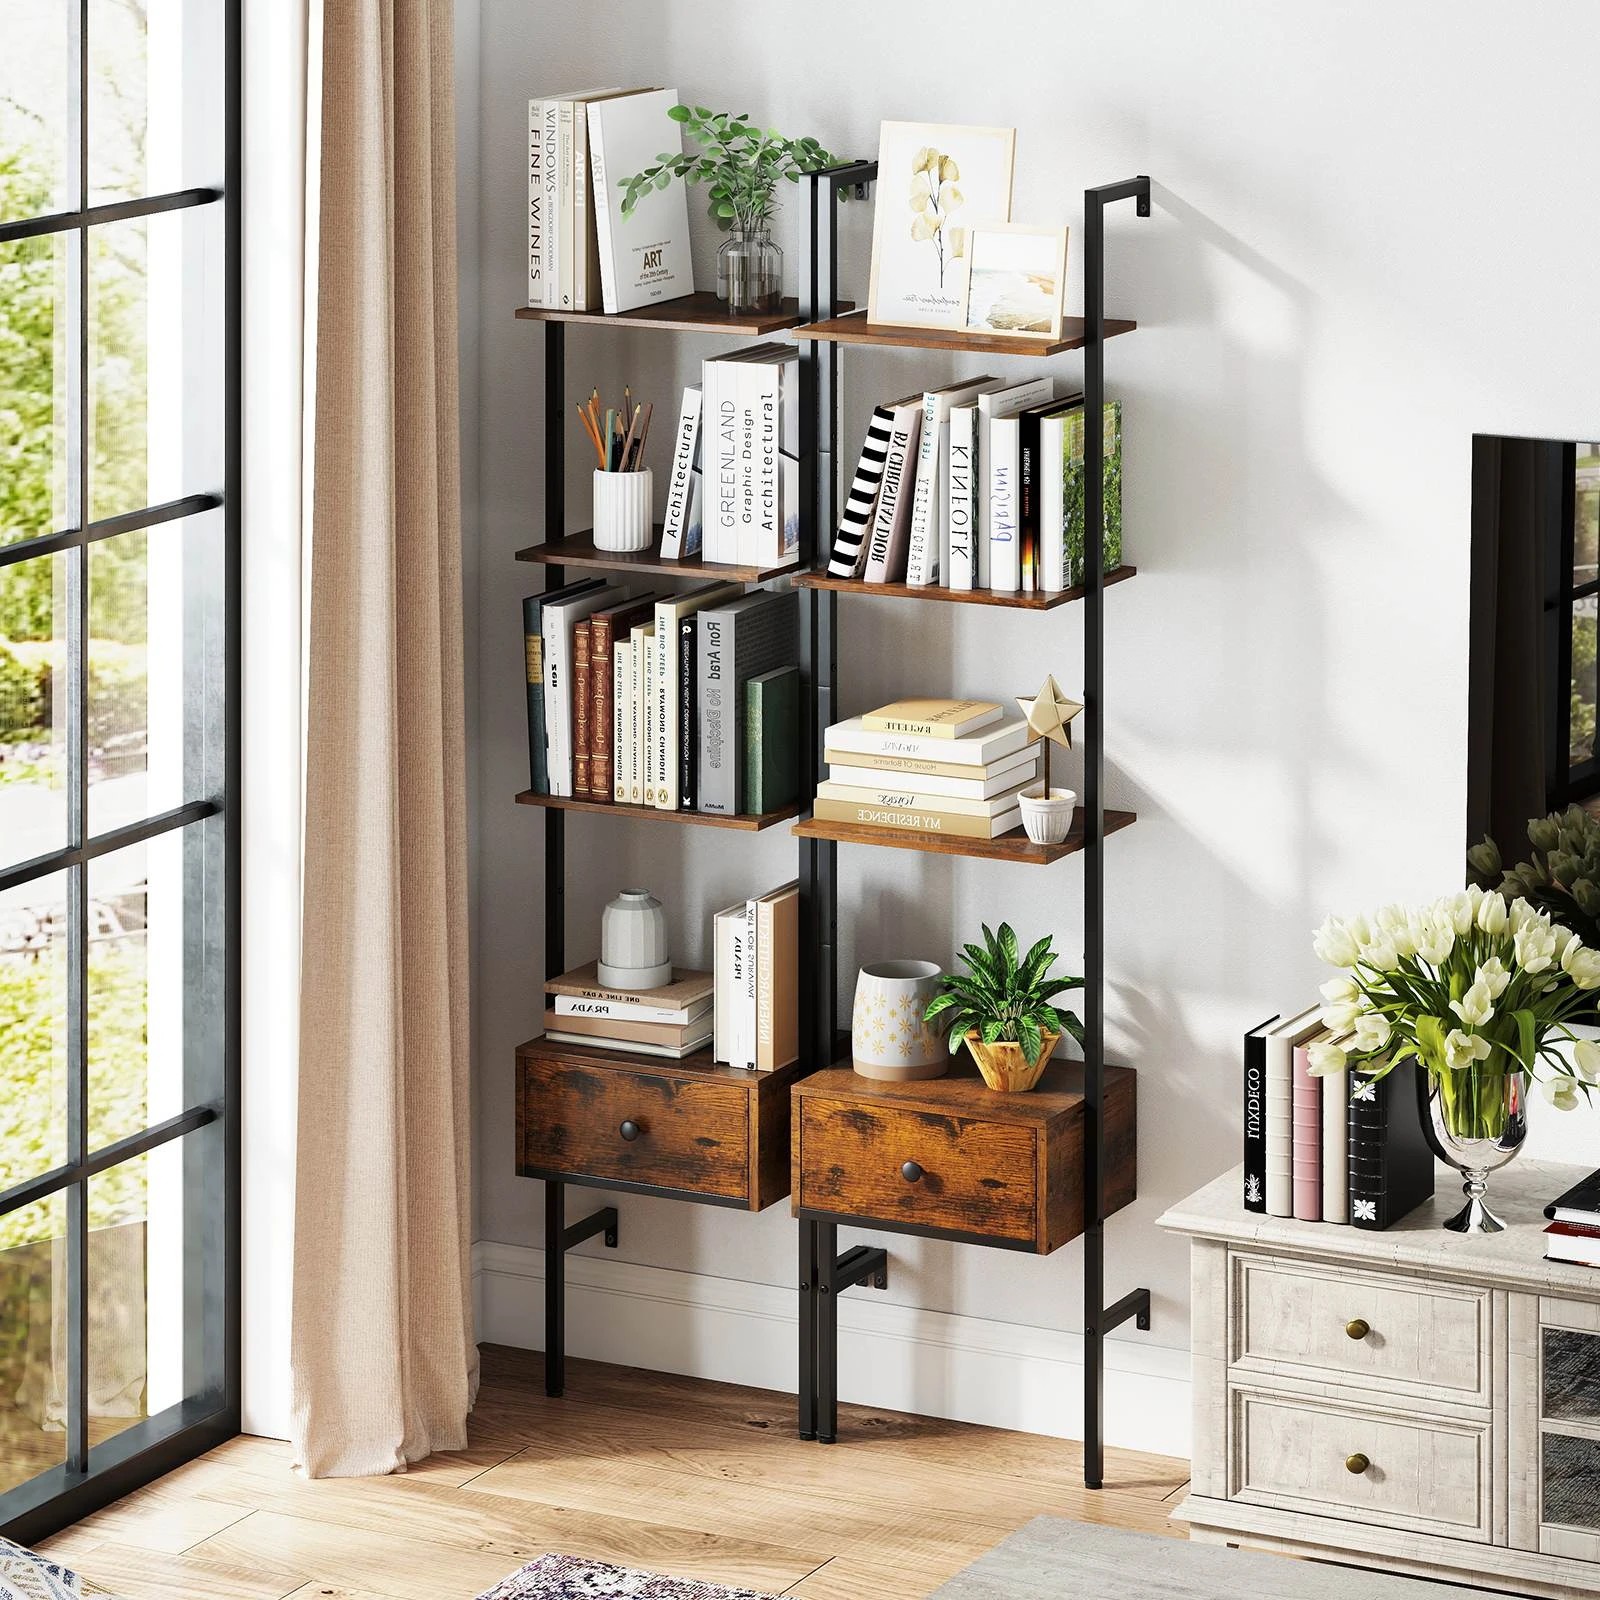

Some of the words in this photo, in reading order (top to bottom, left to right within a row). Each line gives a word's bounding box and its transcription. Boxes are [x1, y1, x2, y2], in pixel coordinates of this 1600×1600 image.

[531, 129, 541, 185] FINE
[546, 108, 556, 193] WINDOWS
[591, 153, 604, 185] ART
[531, 196, 541, 280] WINES
[643, 249, 663, 270] ART
[721, 400, 736, 528] GREENLAND
[742, 409, 755, 460] Design
[760, 392, 774, 531] Architectural
[666, 414, 695, 539] Architectural
[742, 466, 755, 524] Graphic
